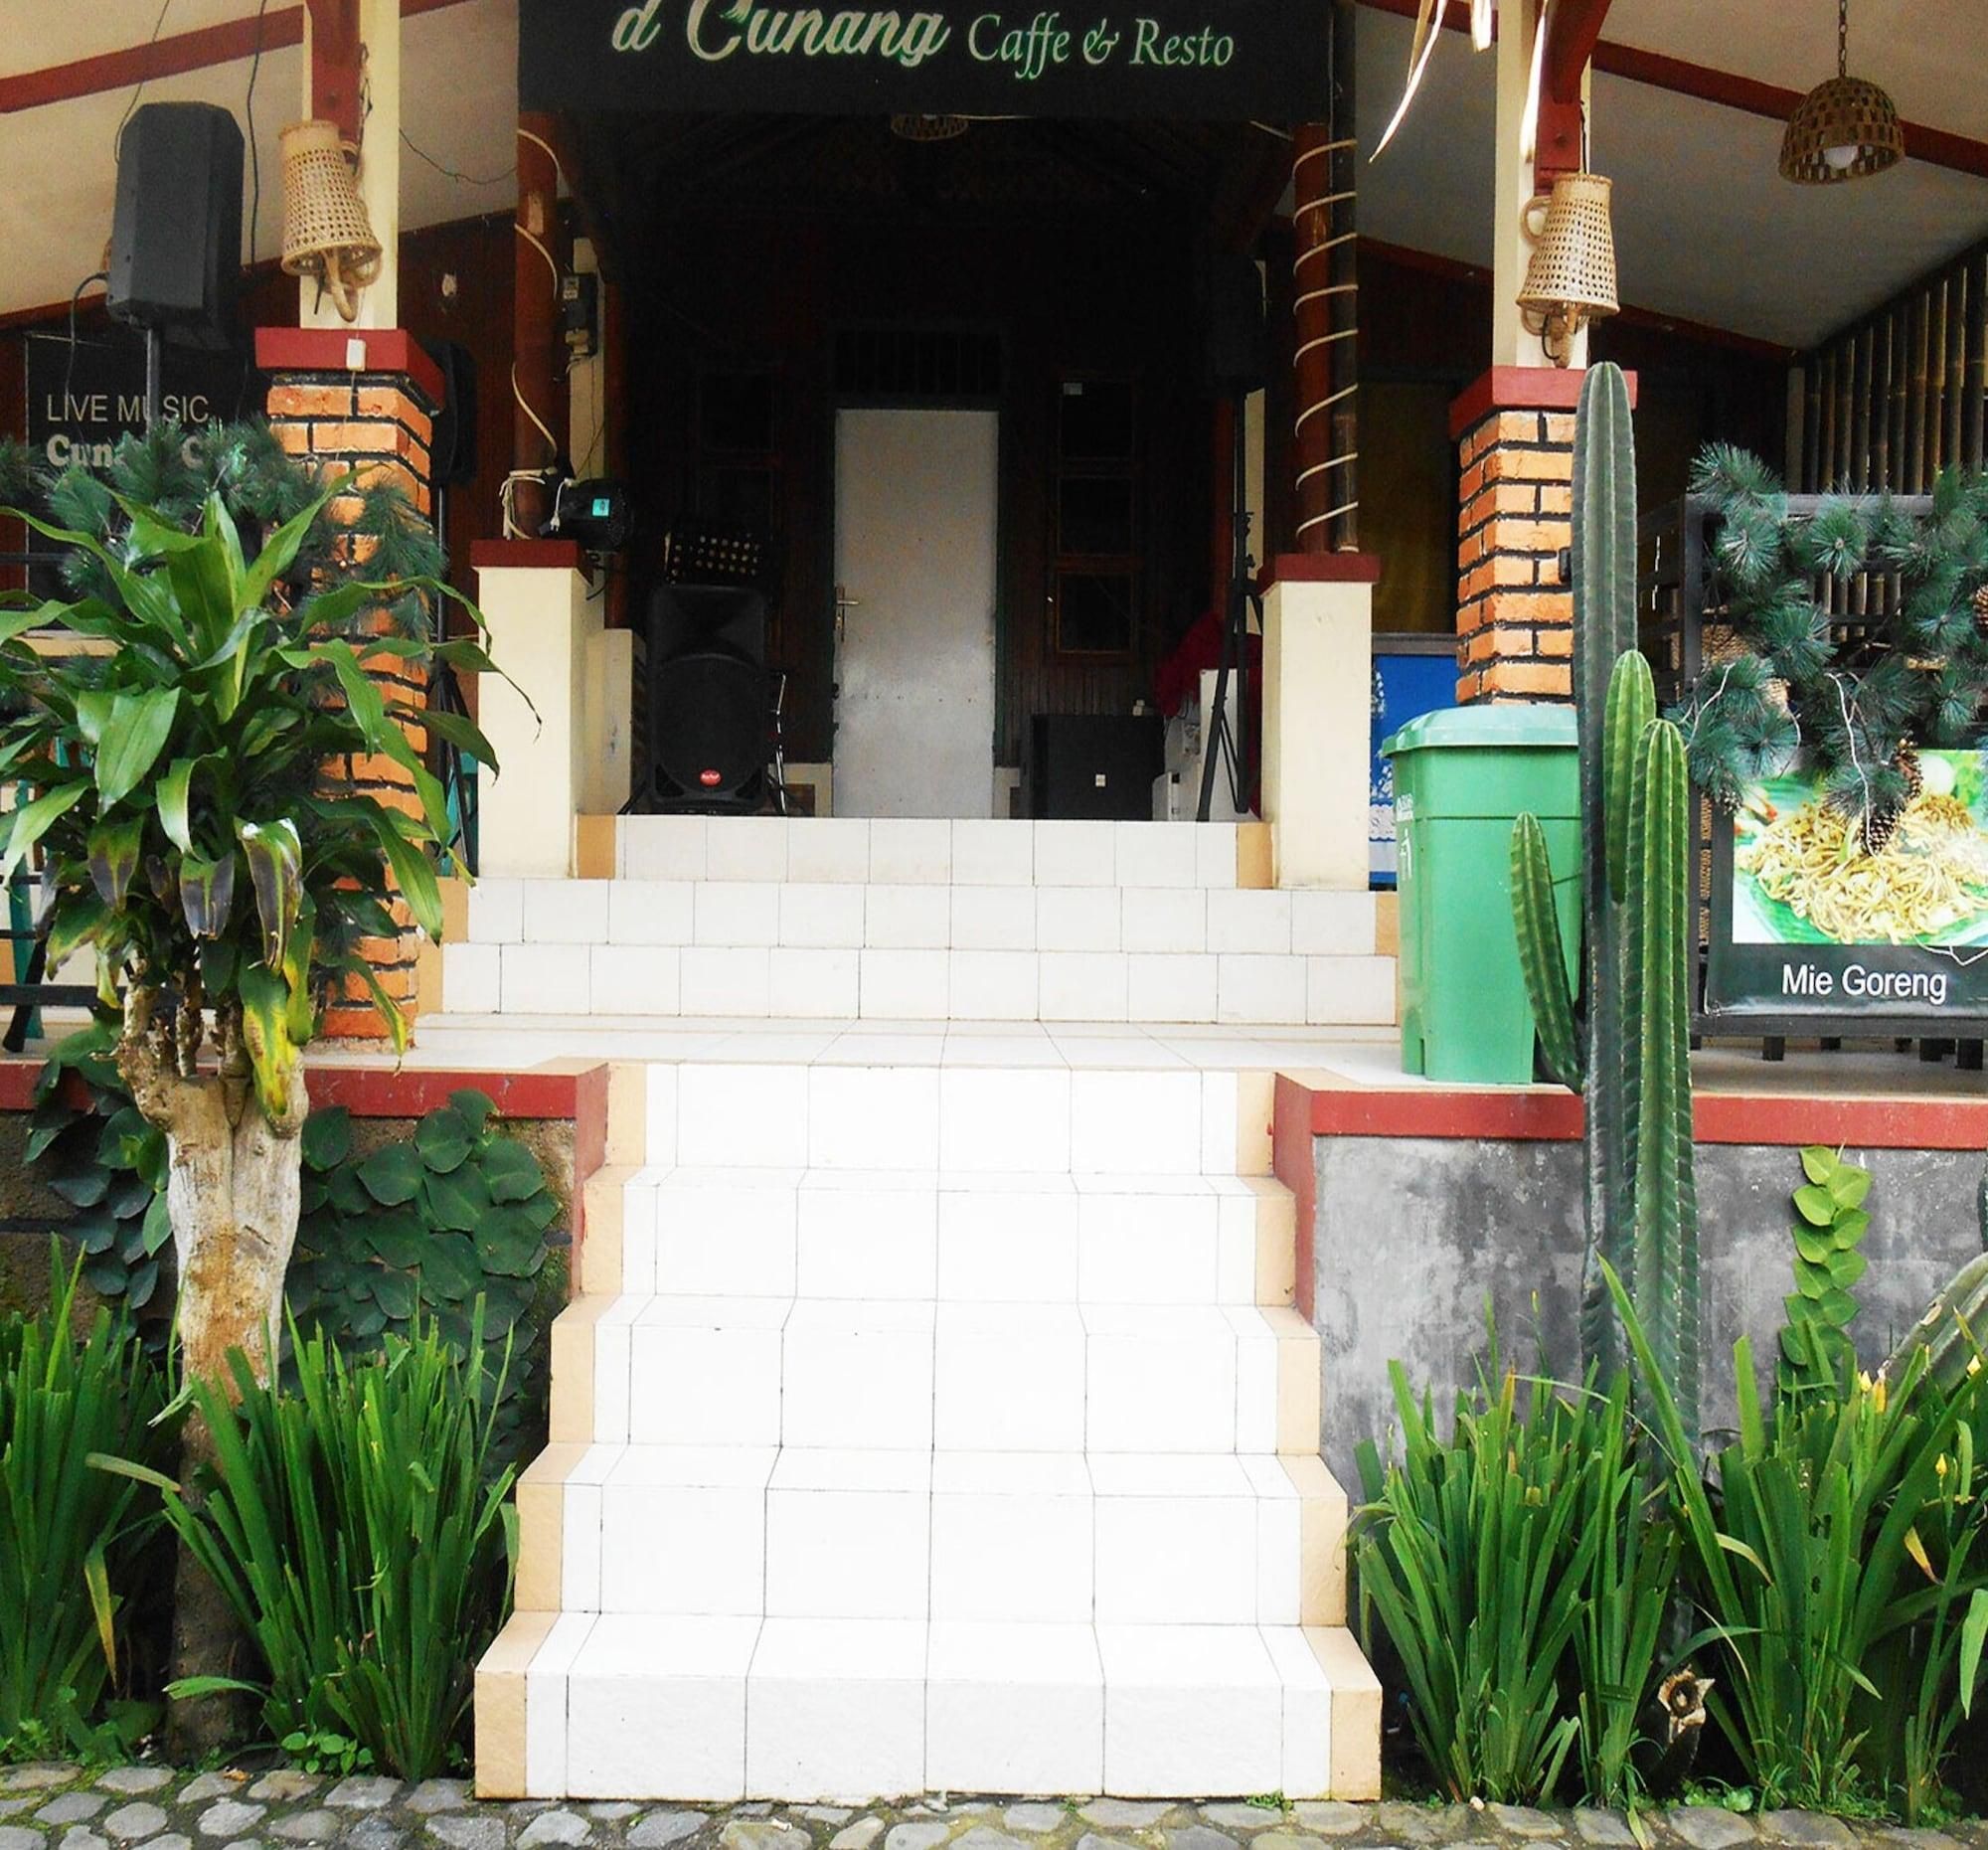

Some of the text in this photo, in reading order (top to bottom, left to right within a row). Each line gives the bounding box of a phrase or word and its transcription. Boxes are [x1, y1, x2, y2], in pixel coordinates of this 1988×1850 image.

[687, 0, 951, 68] Cunang
[968, 12, 1071, 80] Caffe
[1082, 18, 1120, 65] &
[1129, 18, 1235, 67] Resto
[48, 394, 108, 422] LIVE
[1781, 963, 1947, 1006] Mie Goreng
